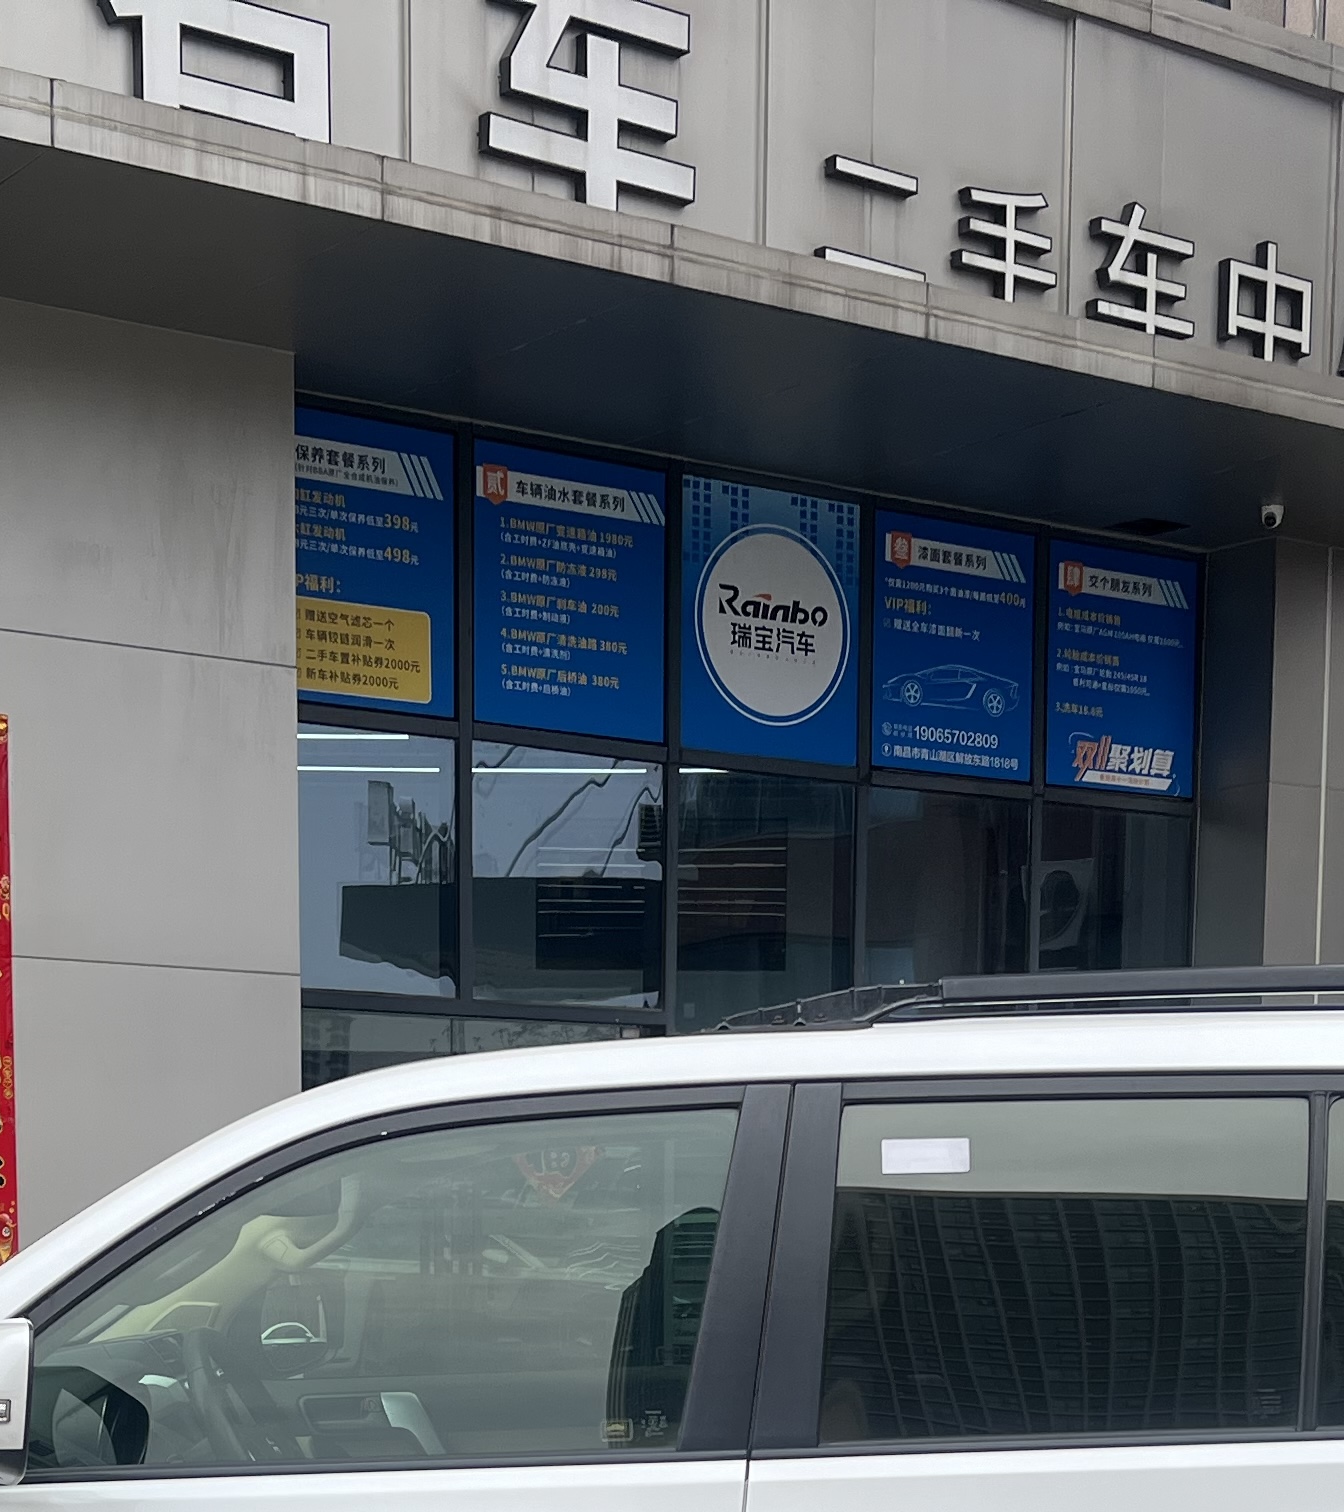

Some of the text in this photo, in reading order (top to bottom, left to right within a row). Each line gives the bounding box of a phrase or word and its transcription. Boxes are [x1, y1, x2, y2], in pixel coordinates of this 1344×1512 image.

[295, 443, 386, 475] 保养套餐系列
[516, 479, 625, 512] 车辆油水套餐系列
[718, 583, 828, 627] Rainbo
[730, 622, 815, 656] 瑞宝汽车
[914, 725, 999, 749] 19065702809
